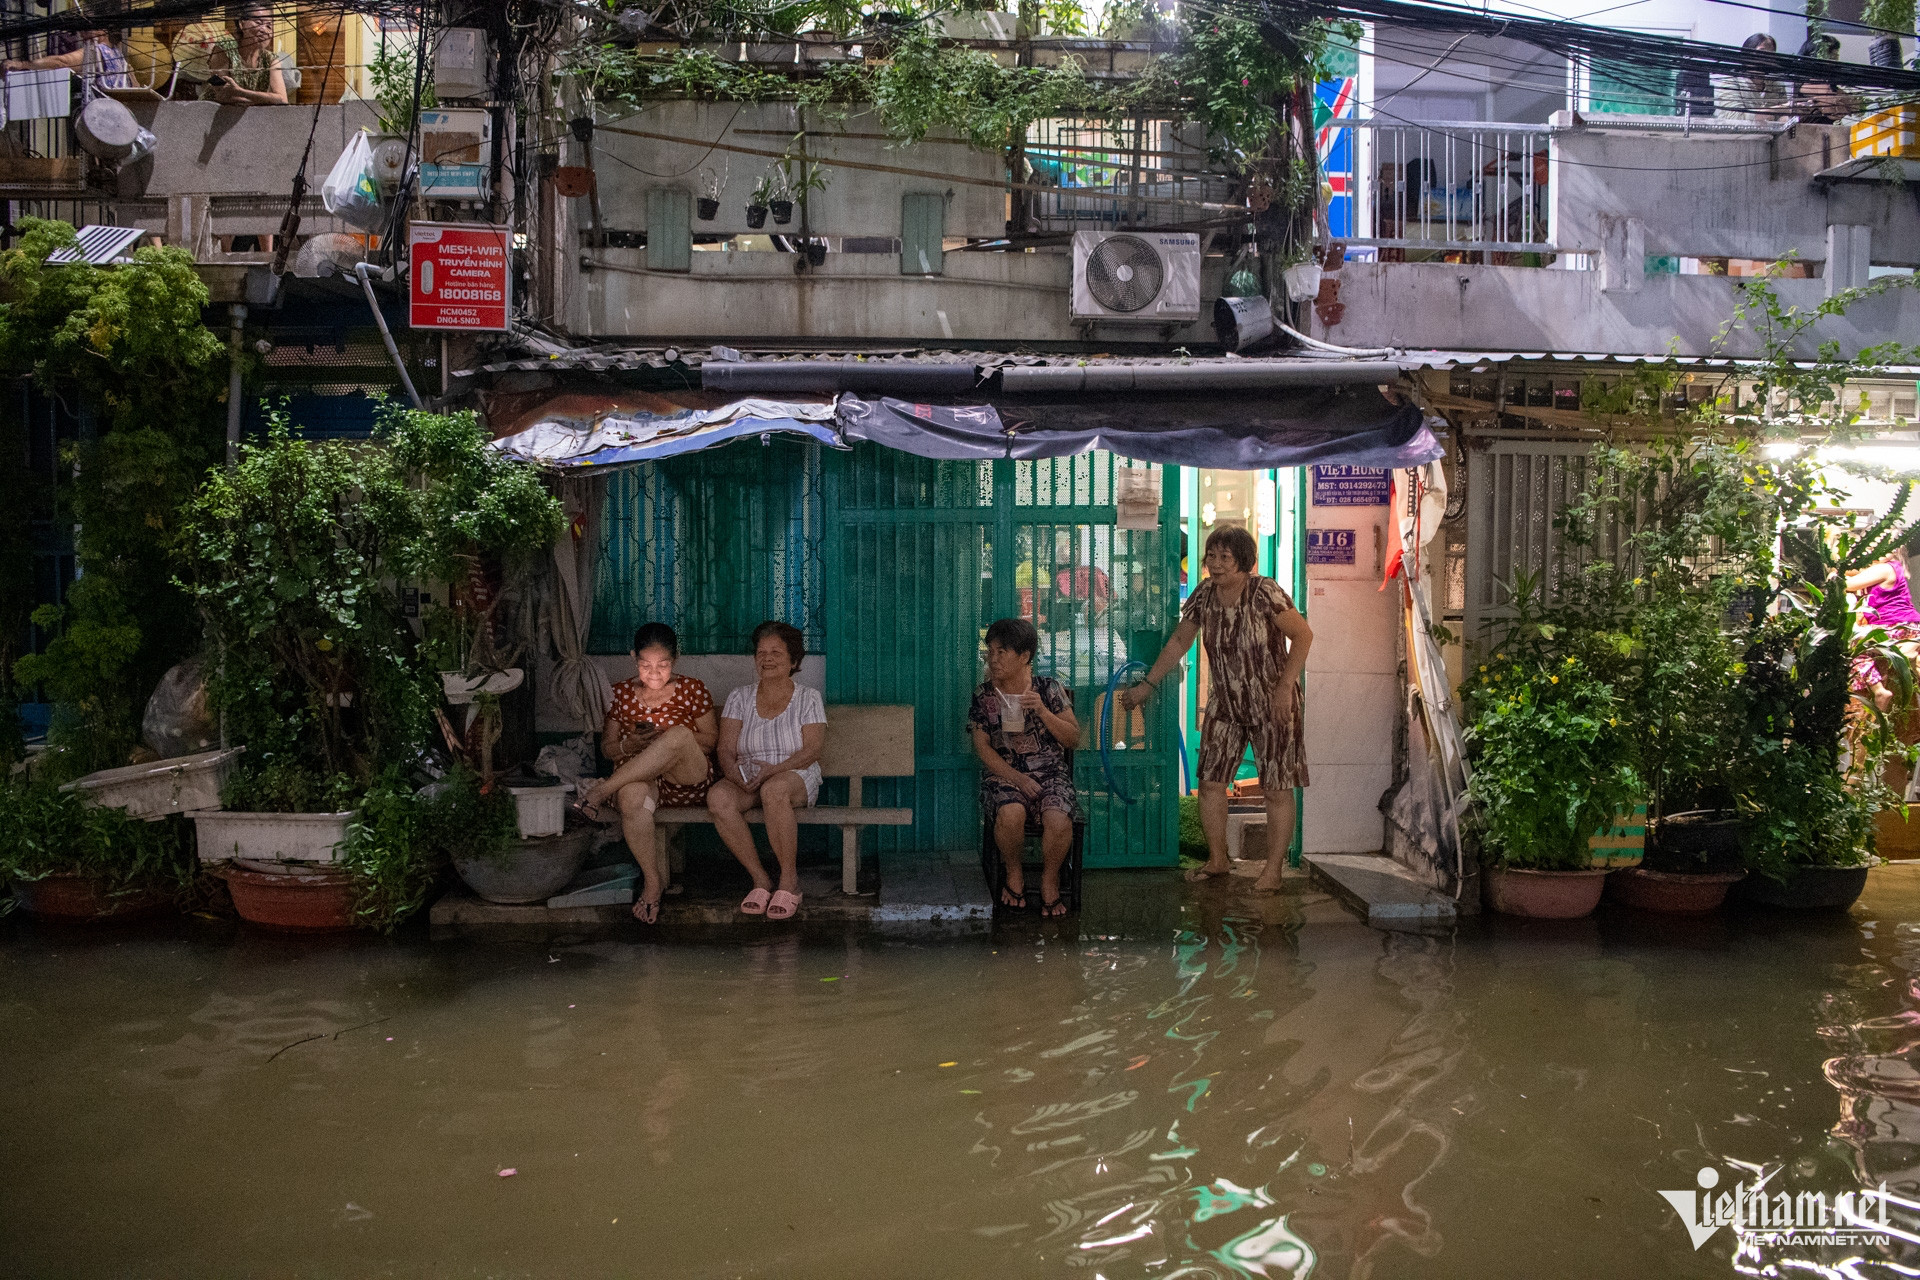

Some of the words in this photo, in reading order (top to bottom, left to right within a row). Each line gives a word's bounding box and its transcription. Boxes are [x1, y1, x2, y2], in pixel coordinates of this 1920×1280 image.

[438, 244, 503, 256] MESH-WIFI
[438, 256, 478, 268] TRUYỀN
[479, 258, 503, 269] HÌNH
[450, 269, 491, 278] CAMERA
[438, 288, 502, 301] 18008168
[440, 308, 477, 316] HCM0452
[436, 316, 481, 325] DN04-SN03
[1317, 482, 1337, 490] MST:
[1316, 532, 1348, 547] 116
